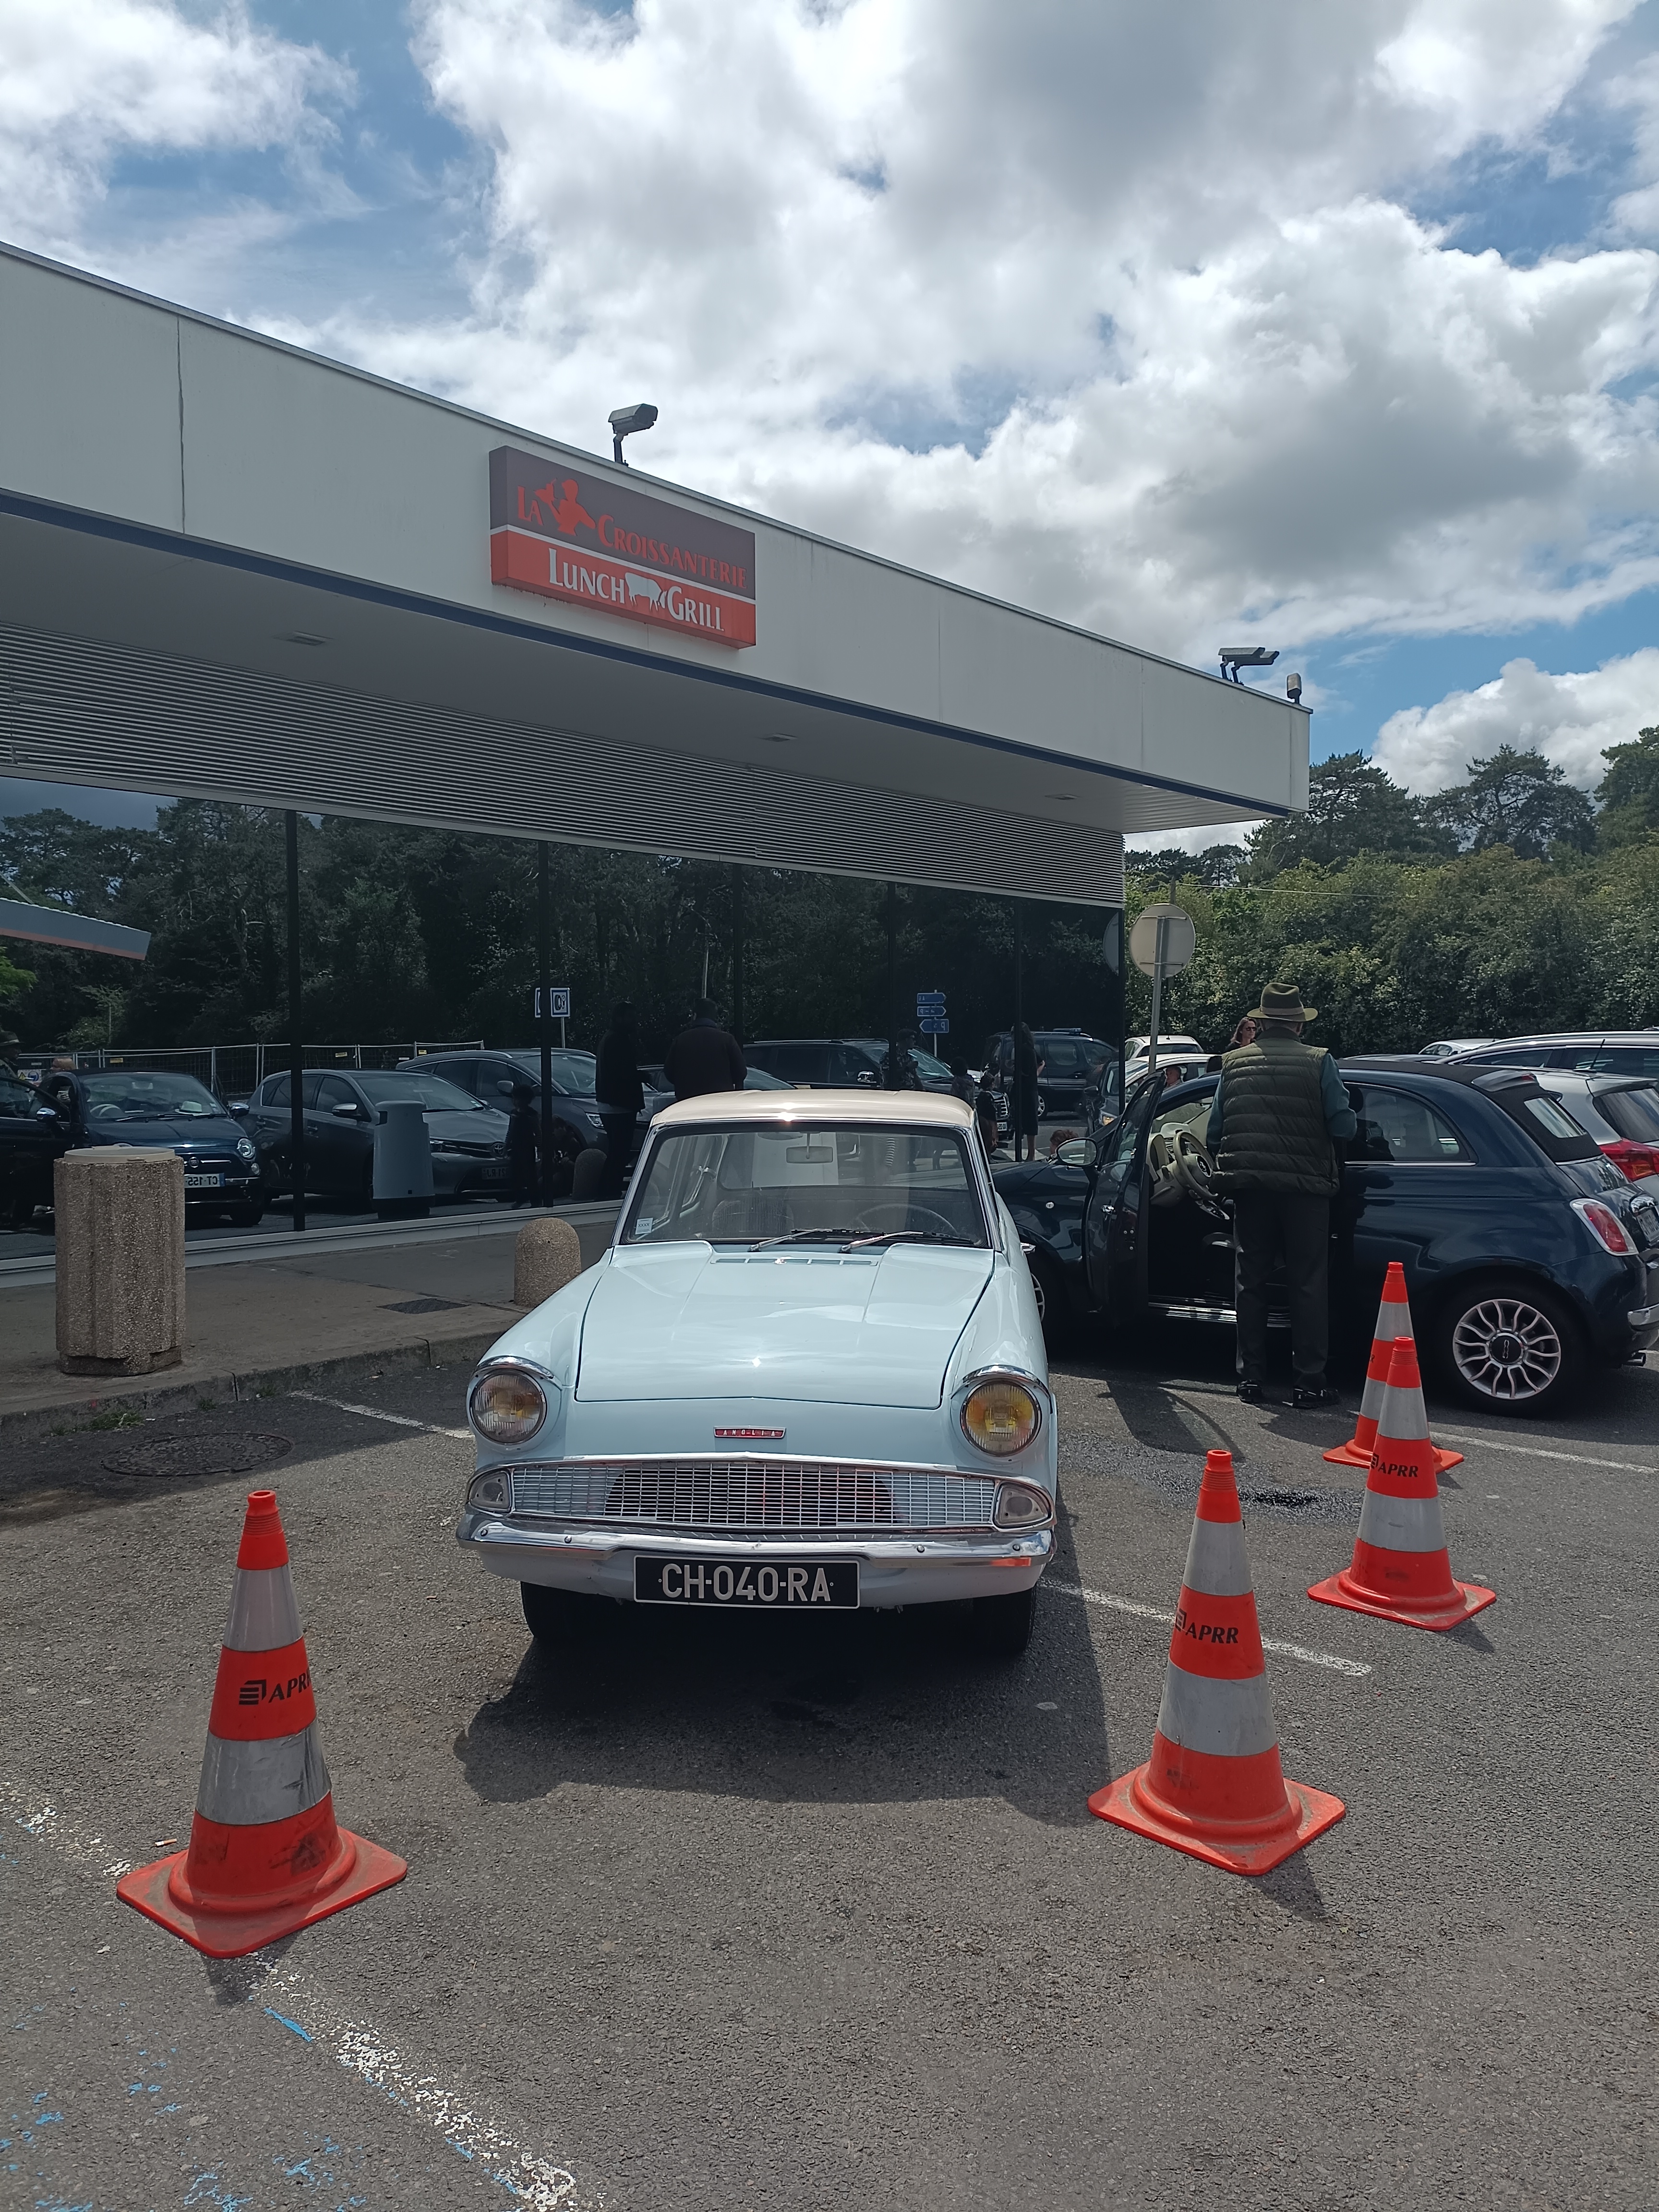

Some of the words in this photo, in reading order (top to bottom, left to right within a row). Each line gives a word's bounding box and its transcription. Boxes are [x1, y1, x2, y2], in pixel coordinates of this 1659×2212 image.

[517, 485, 543, 526] LA
[598, 515, 747, 589] CROISSANTERIE
[549, 548, 625, 604] LUNCH
[667, 586, 724, 631] GRILL
[1378, 1462, 1419, 1477] APRR
[662, 1563, 830, 1601] CH-040-RA
[1185, 1622, 1238, 1644] APRR
